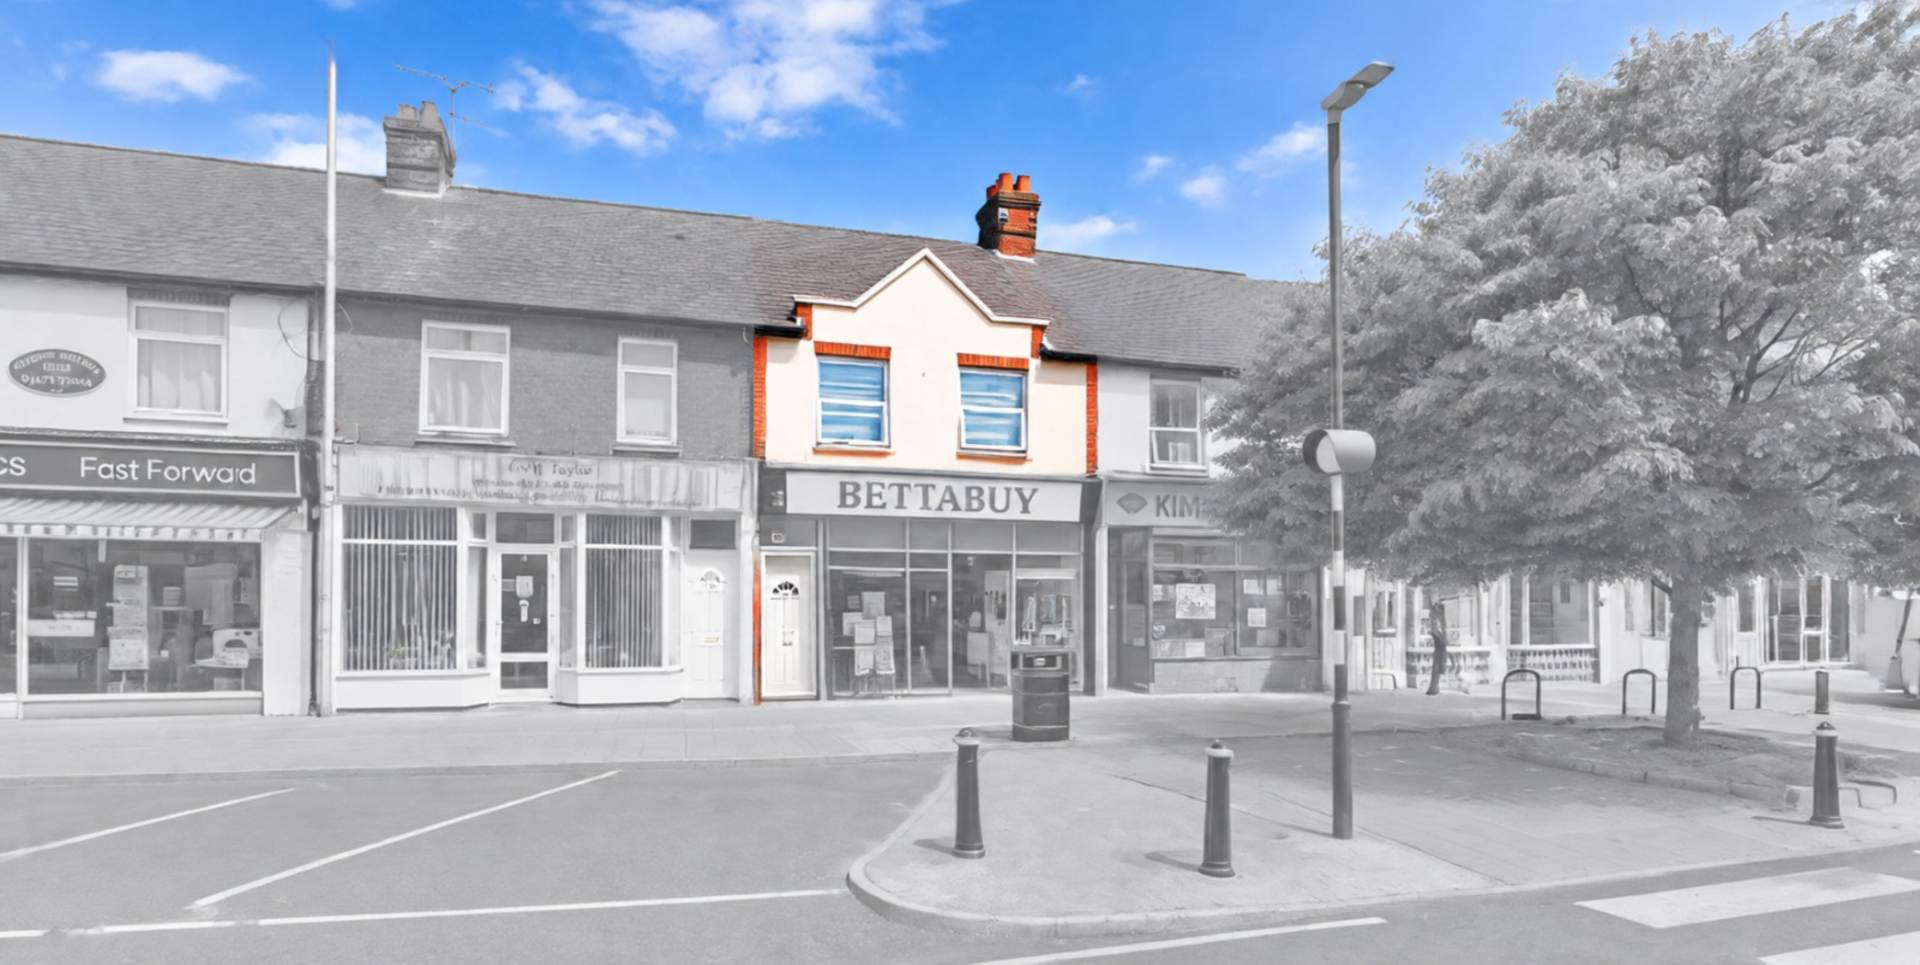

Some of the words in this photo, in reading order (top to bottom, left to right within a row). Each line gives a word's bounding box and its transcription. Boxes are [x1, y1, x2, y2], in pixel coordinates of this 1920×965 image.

[80, 456, 140, 481] Fast
[147, 459, 256, 485] Forward
[836, 481, 1040, 515] BETTABUY
